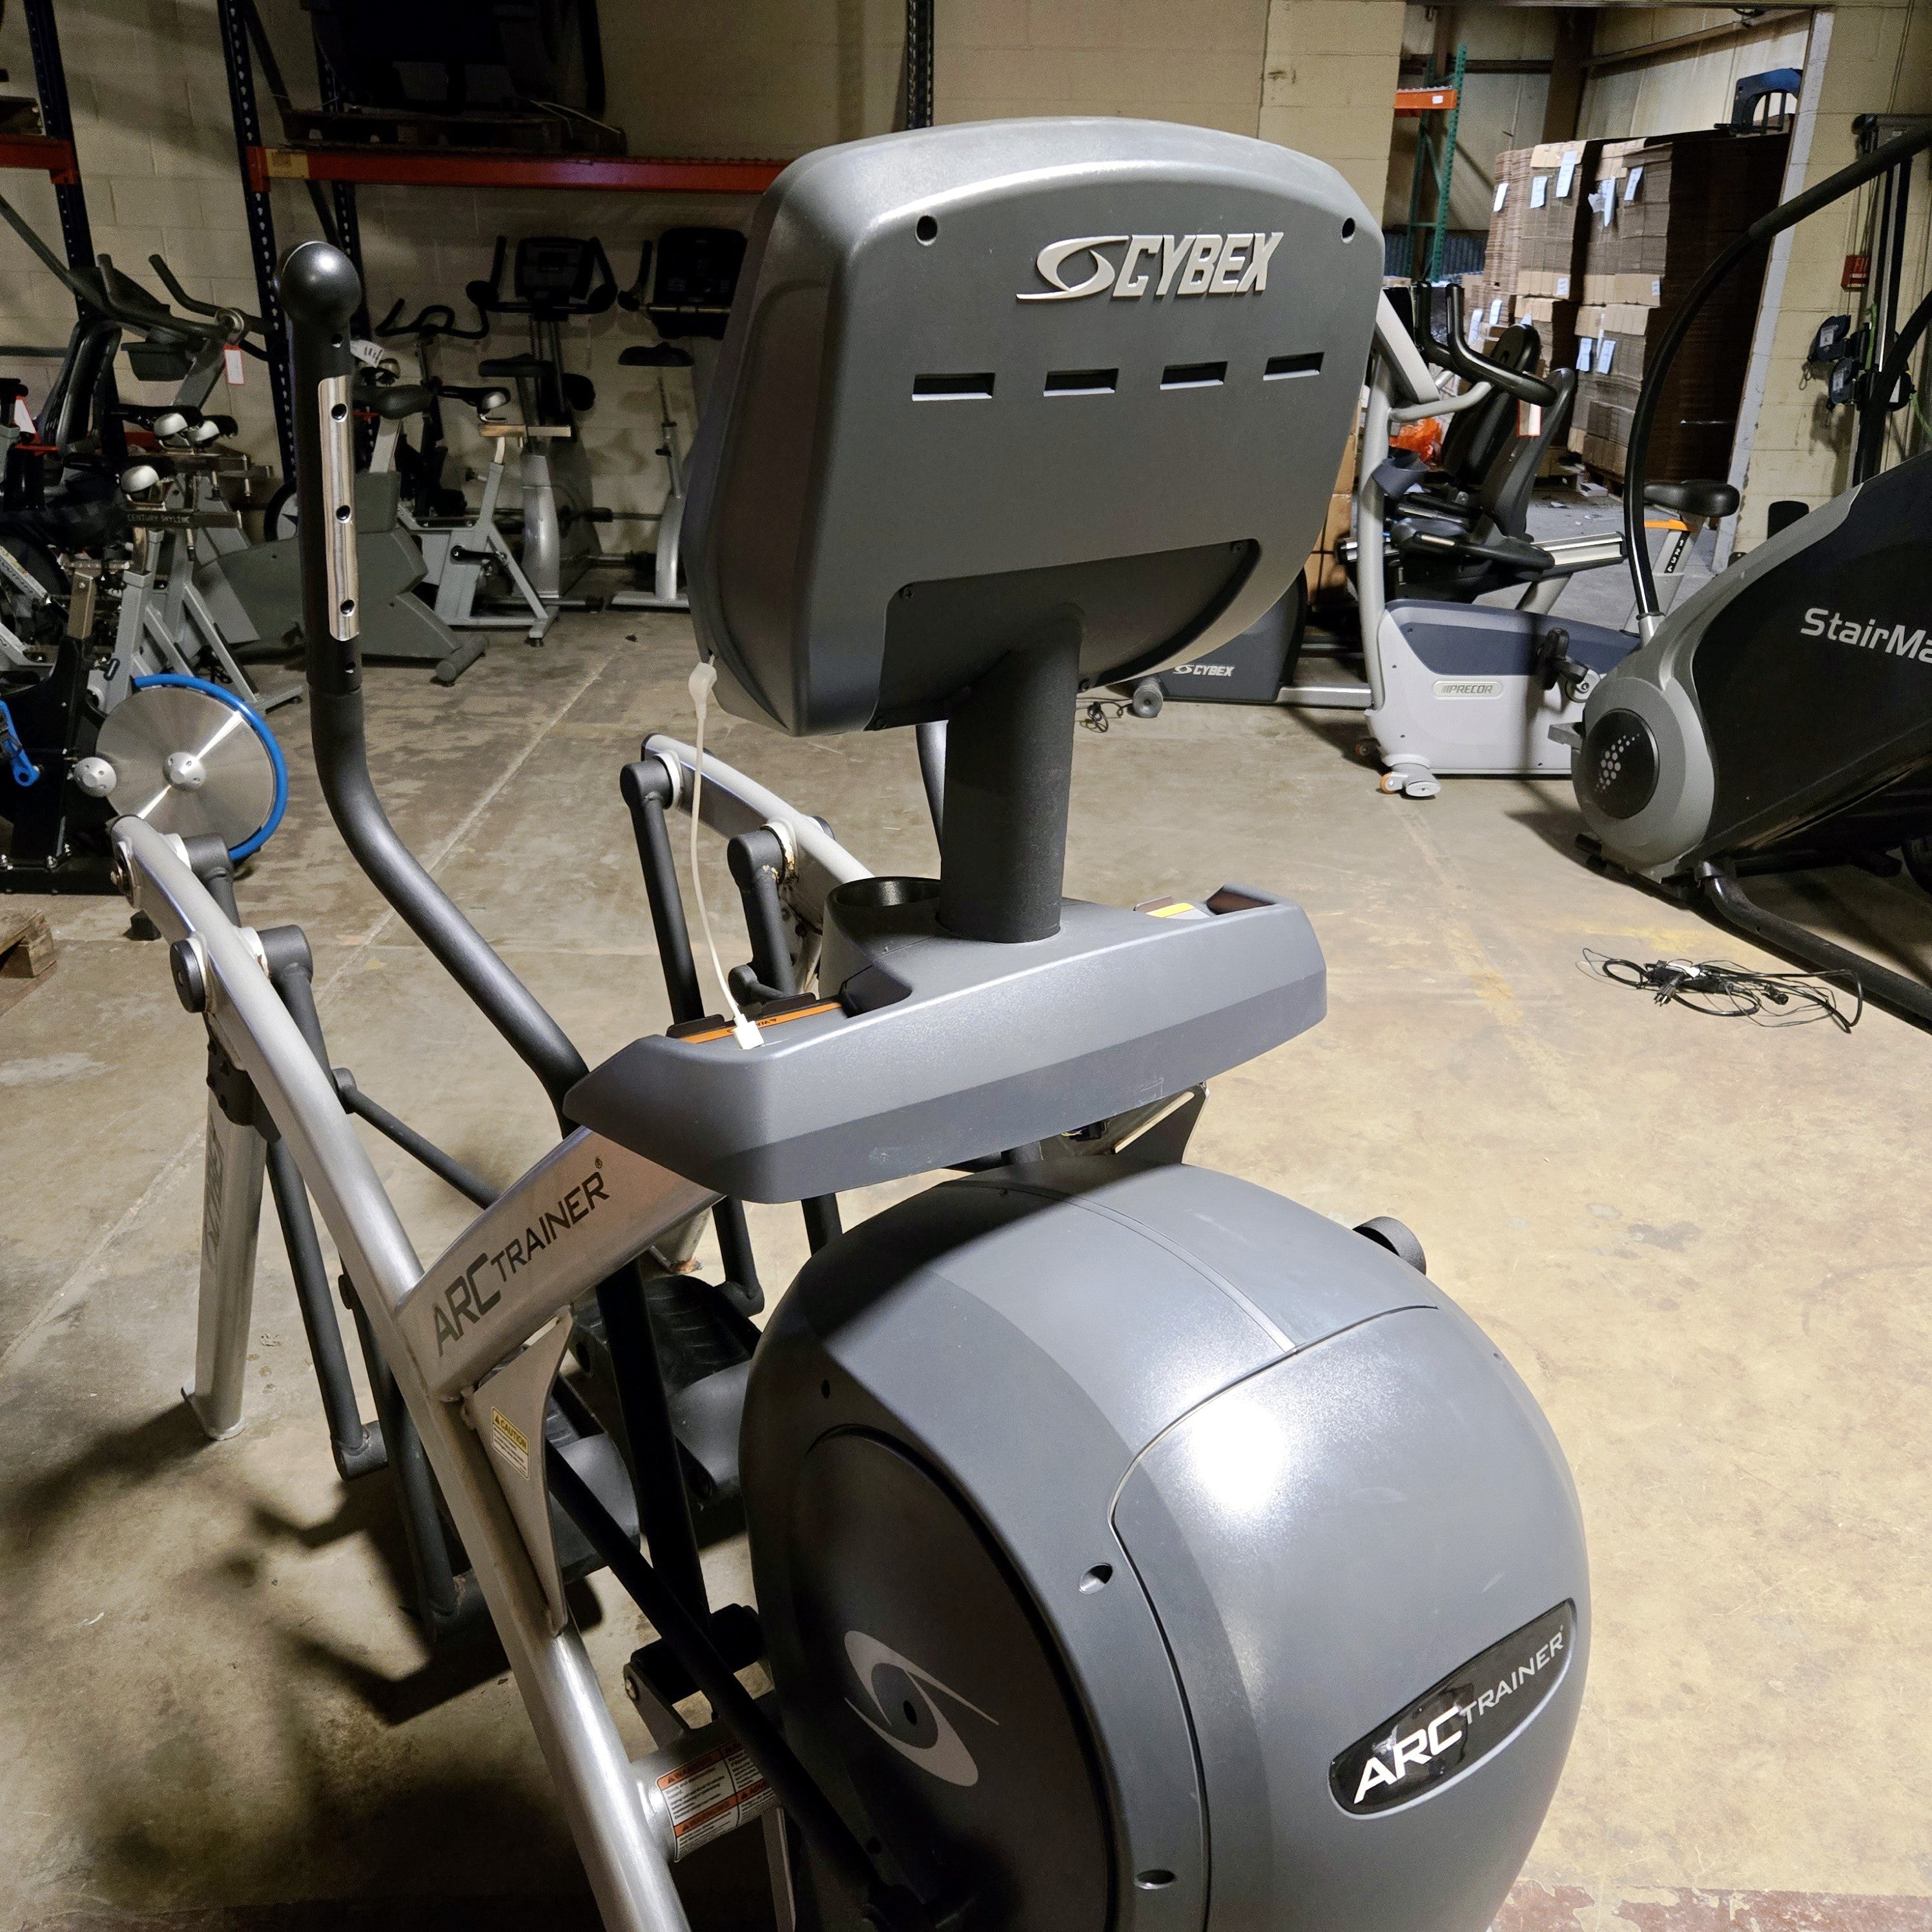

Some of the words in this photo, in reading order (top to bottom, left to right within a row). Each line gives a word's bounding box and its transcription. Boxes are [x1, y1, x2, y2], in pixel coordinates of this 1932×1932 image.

[1113, 232, 1284, 298] CYBEX
[1193, 665, 1235, 677] CYBEX
[1448, 684, 1494, 694] PRECOR
[433, 1253, 502, 1357] ARC
[500, 1419, 527, 1450] CAUTION
[1353, 1705, 1463, 1804] ARC
